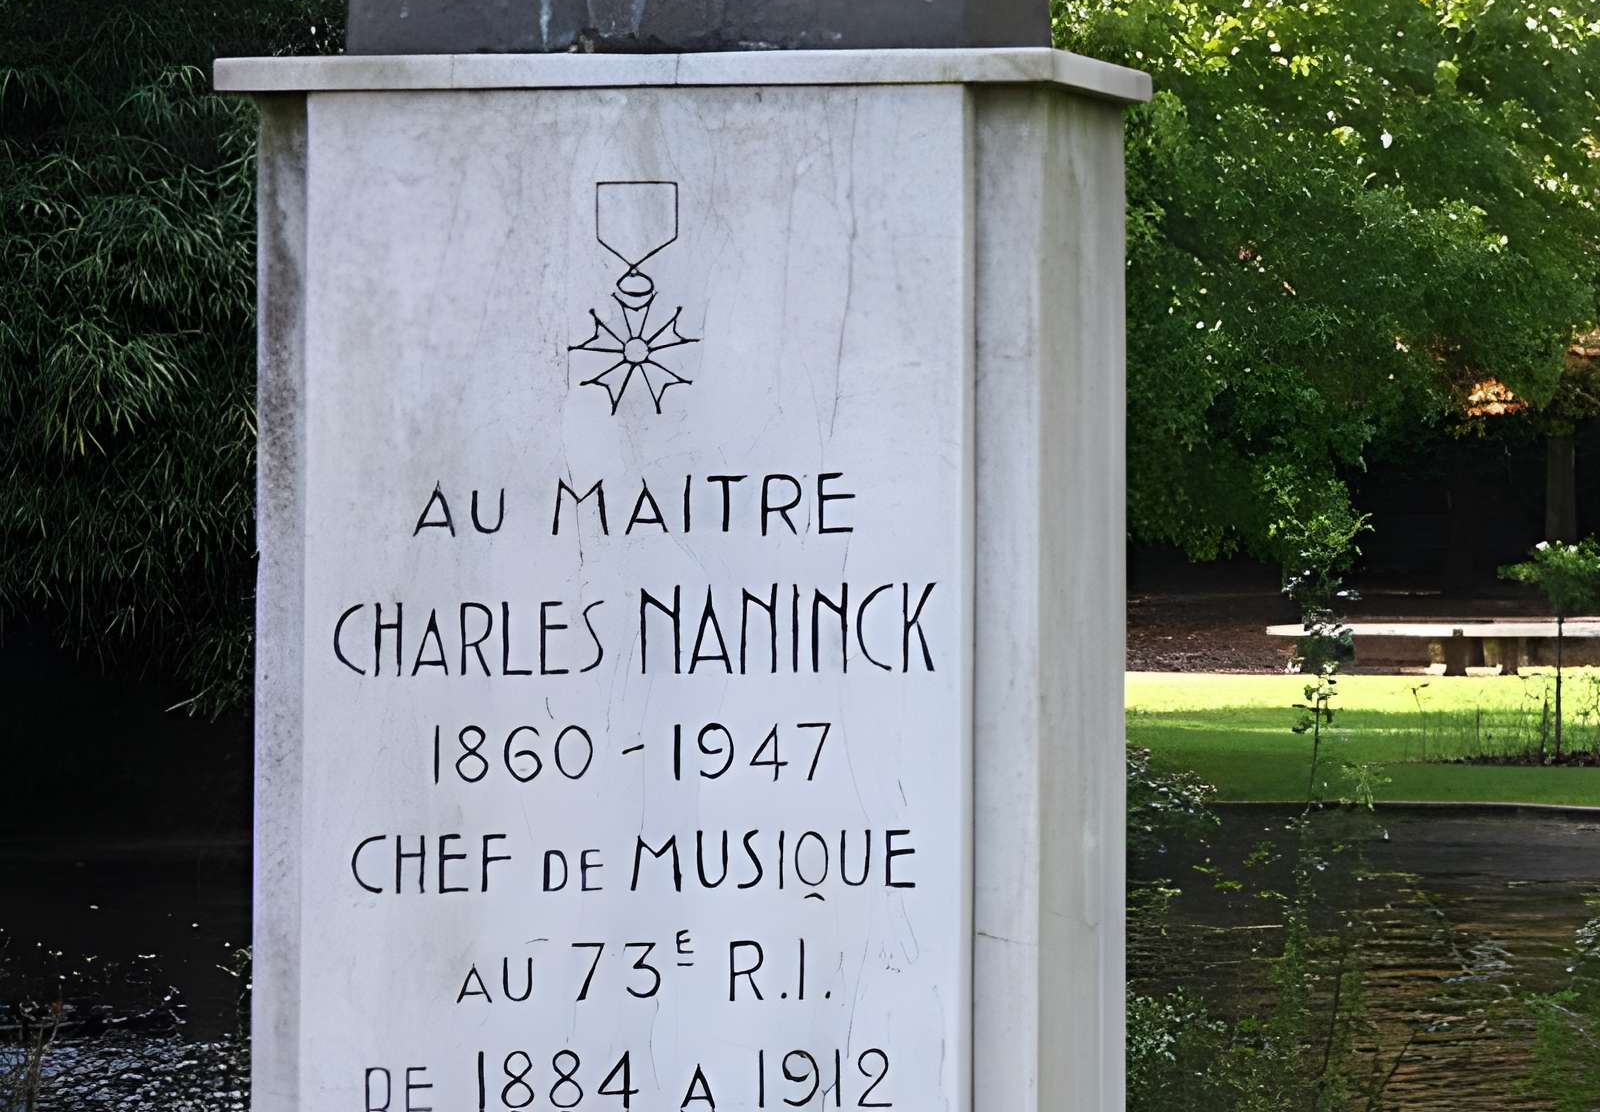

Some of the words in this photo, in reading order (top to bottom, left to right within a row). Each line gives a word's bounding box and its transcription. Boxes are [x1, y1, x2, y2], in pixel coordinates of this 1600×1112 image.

[412, 480, 505, 538] AU
[552, 472, 856, 537] MAITRE
[333, 600, 605, 677] CHARLES
[640, 582, 937, 675] NANINCK
[434, 724, 594, 785] 1860
[673, 722, 832, 782] 1947
[351, 833, 512, 895] CHEF
[542, 849, 604, 892] DE
[630, 829, 917, 902] MUSIQUE
[456, 956, 534, 1004] AU
[729, 937, 832, 1002] R.I.
[364, 1066, 433, 1112] DE
[477, 1049, 640, 1110] 1884
[680, 1063, 716, 1110] A
[758, 1048, 893, 1109] 1912
